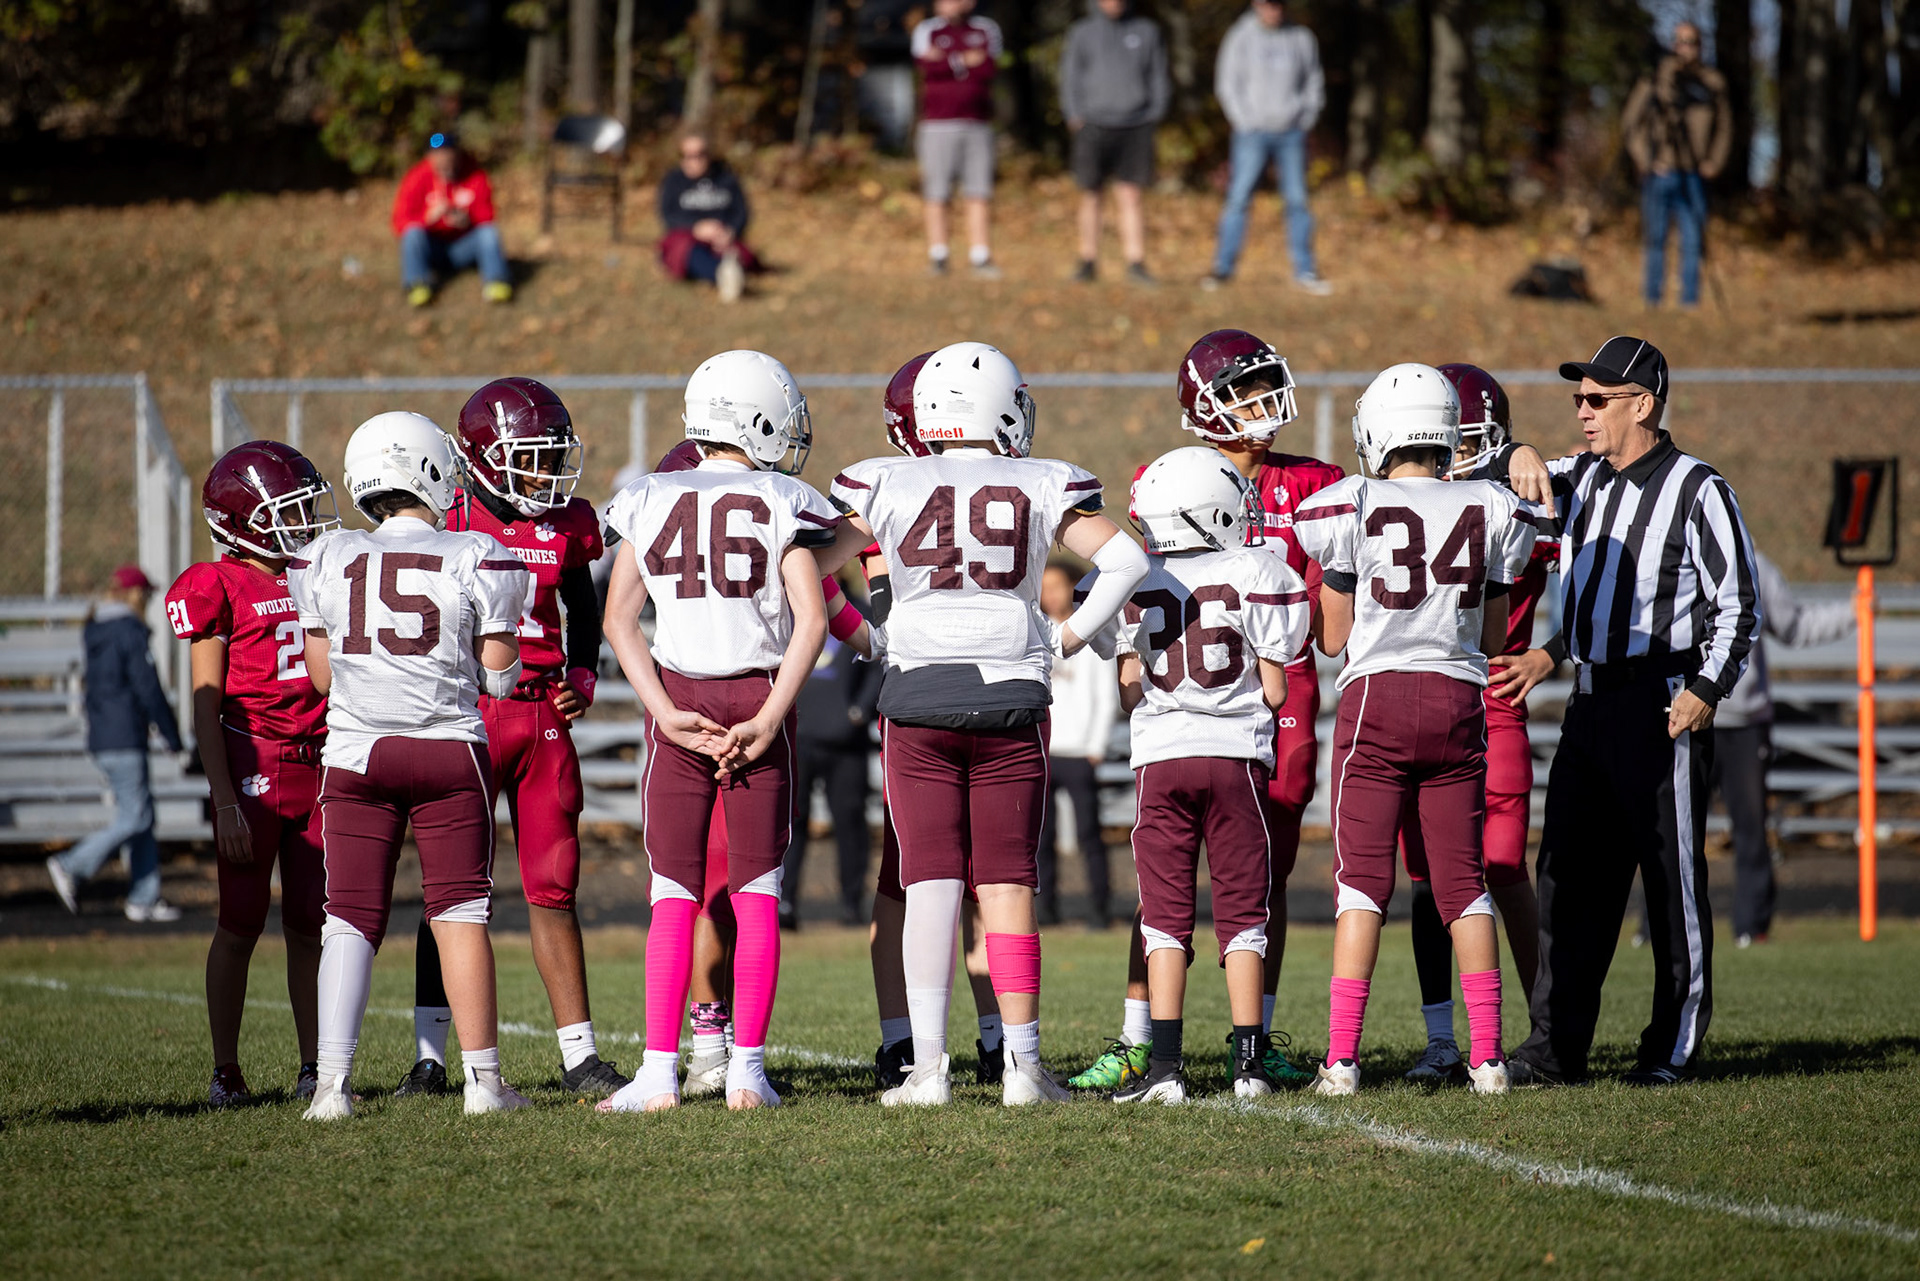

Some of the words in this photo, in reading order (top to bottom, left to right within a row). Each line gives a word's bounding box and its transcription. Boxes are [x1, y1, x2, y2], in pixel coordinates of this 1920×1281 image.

[918, 427, 964, 440] Riddell
[1407, 431, 1445, 441] schutt
[353, 477, 382, 494] schutt
[897, 485, 1031, 590] 49
[1249, 511, 1293, 528] INES
[643, 491, 771, 599] 46
[1365, 505, 1487, 610] 34
[167, 599, 194, 635] 21
[252, 597, 297, 616] WOLVE
[342, 552, 443, 655] 15
[275, 619, 309, 681] 2
[1123, 583, 1245, 693] 36
